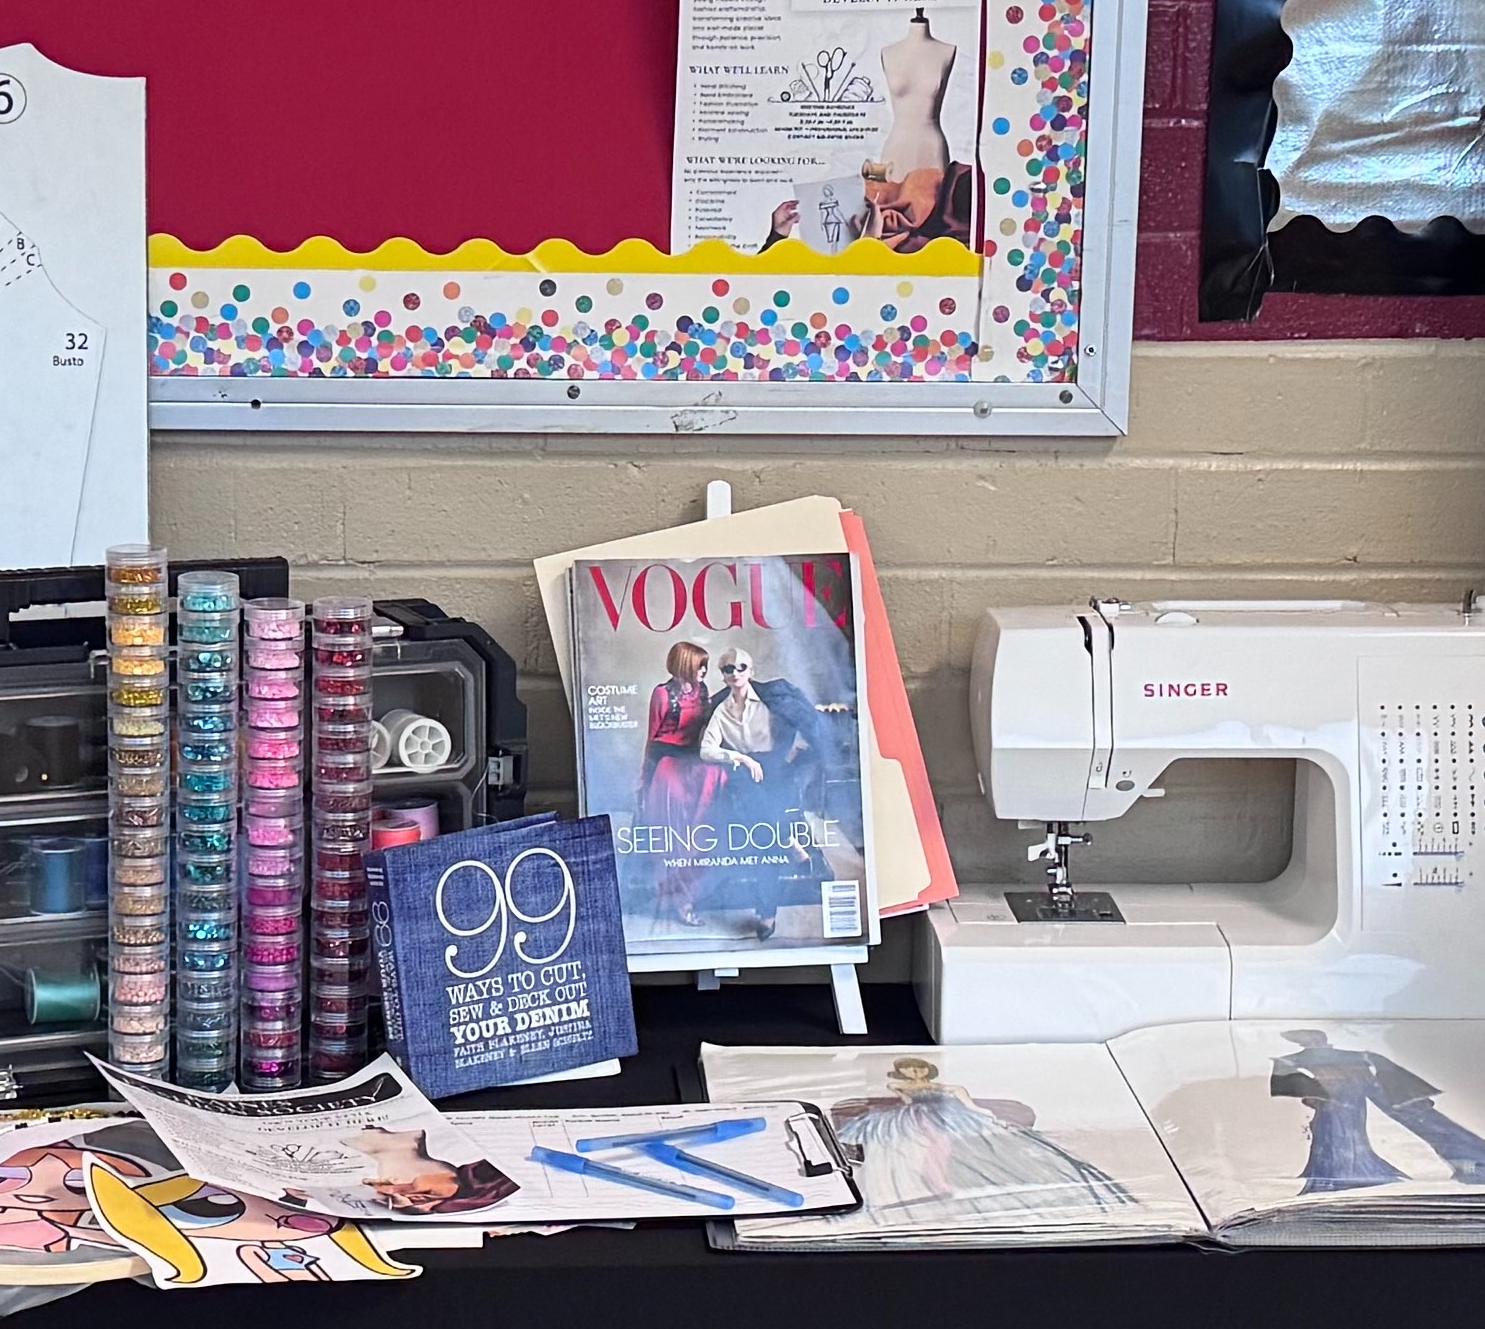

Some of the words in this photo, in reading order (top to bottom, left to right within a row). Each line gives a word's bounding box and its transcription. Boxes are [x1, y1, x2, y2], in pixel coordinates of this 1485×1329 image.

[16, 237, 25, 251] B
[26, 253, 35, 267] C
[64, 333, 90, 351] 32
[51, 354, 85, 368] Busto
[588, 562, 848, 634] VOGUE
[1142, 682, 1230, 699] SINGER
[617, 823, 718, 854] SEEING
[728, 820, 841, 852] DOUBLE
[664, 855, 692, 868] WHEN
[694, 855, 738, 867] MIRANDA
[740, 855, 758, 866] MET
[761, 854, 790, 865] ANNA
[435, 846, 577, 979] 99
[445, 976, 504, 1005] WAYS
[508, 969, 536, 993] TO
[539, 960, 587, 987] CUT,
[449, 1002, 484, 1025] SEW
[489, 999, 504, 1014] &
[507, 988, 552, 1014] DECK
[554, 981, 588, 1006] OUT
[450, 1013, 513, 1045] YOUR
[514, 998, 592, 1032] DENIM
